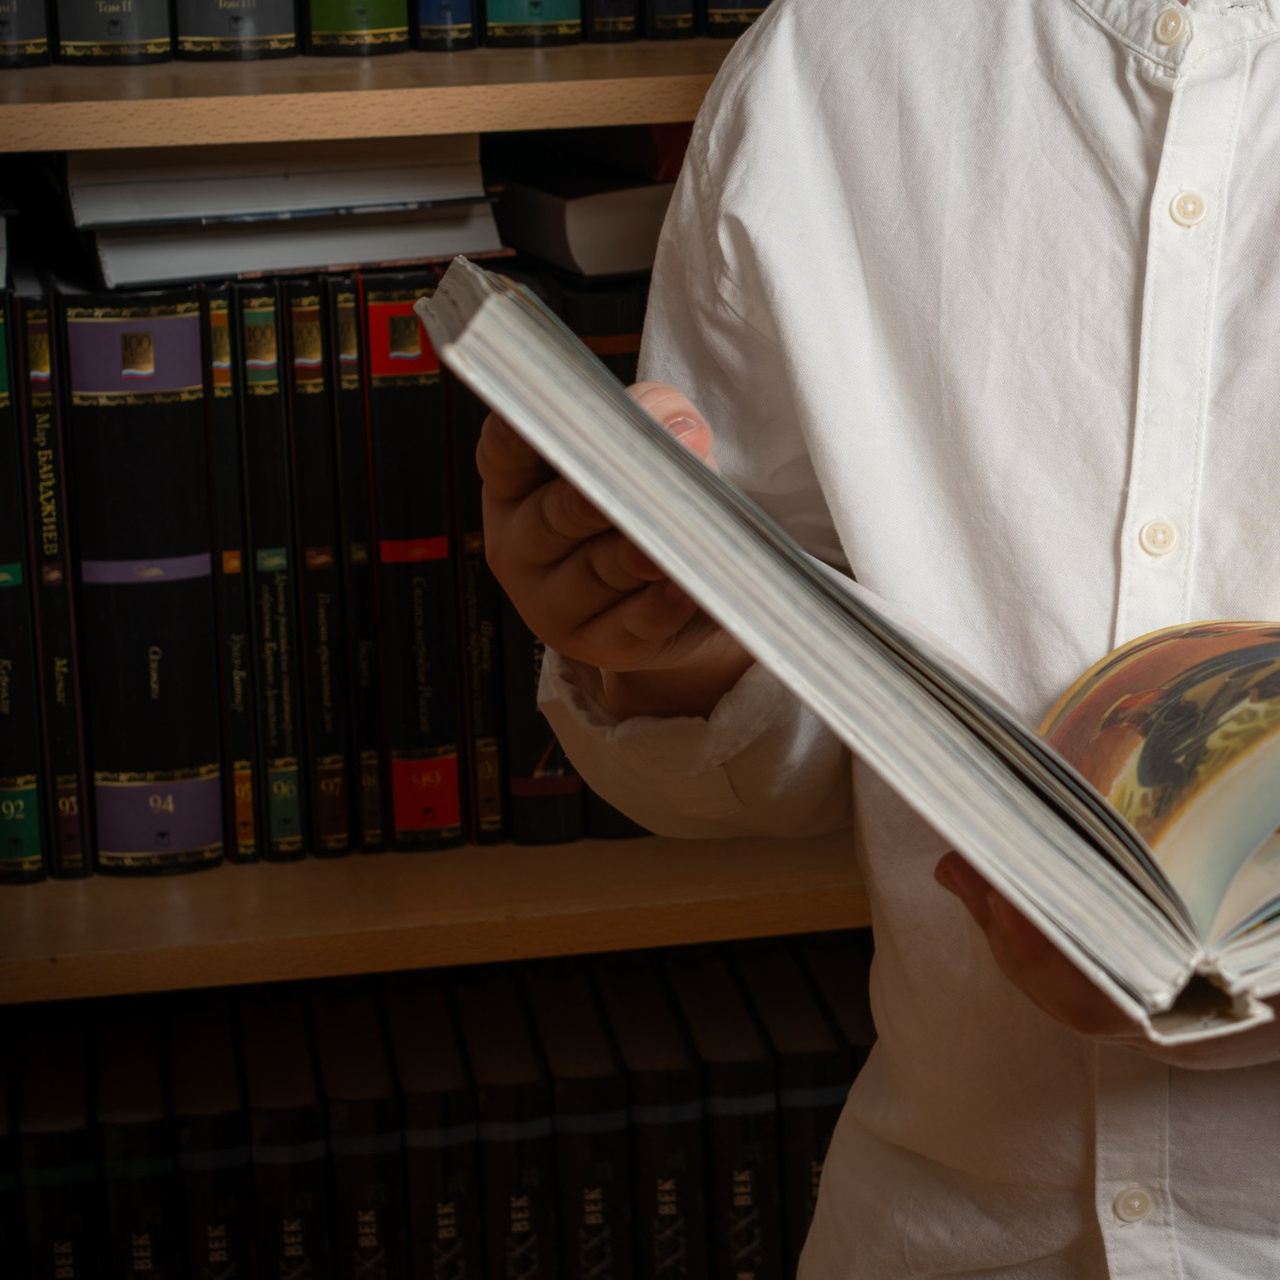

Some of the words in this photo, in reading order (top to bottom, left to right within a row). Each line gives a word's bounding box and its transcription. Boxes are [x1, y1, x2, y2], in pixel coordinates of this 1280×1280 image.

[33, 412, 51, 447] Мар
[36, 449, 57, 556] БАЙДЖИЕВ
[1, 800, 26, 821] 92
[148, 795, 176, 814] 94
[436, 1202, 457, 1239] ВЕК
[583, 1187, 605, 1224] ВЕК
[207, 1225, 228, 1262] ВЕК
[283, 1219, 304, 1256] ВЕК
[358, 1210, 379, 1248] ВЕК
